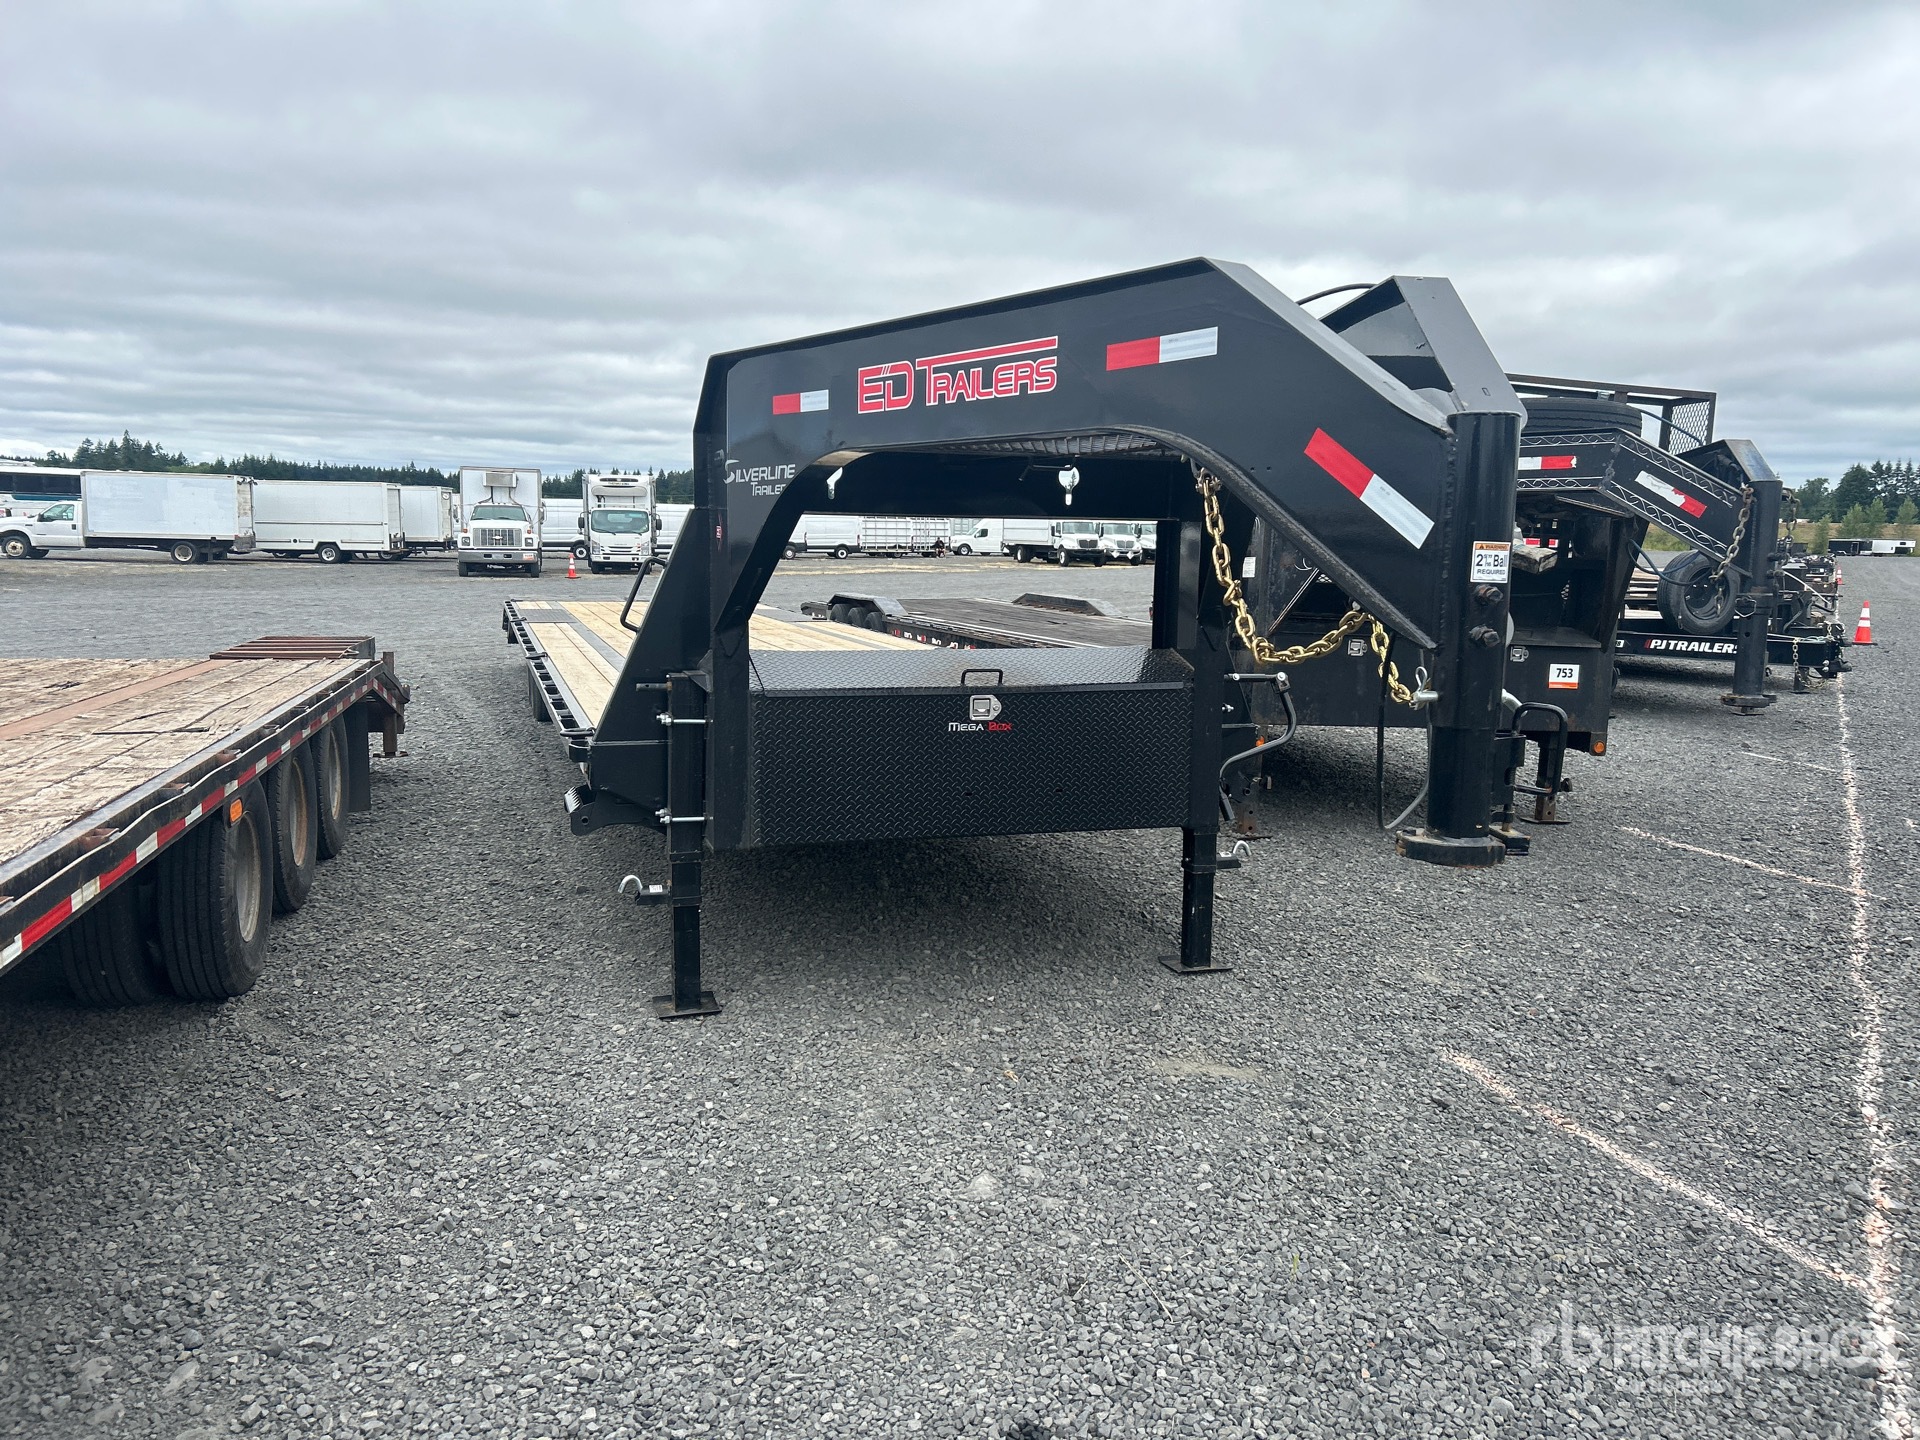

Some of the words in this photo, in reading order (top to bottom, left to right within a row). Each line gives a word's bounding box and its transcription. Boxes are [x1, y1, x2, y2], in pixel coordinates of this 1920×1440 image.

[857, 361, 914, 414] ED
[915, 336, 1058, 406] TRAILERS
[723, 460, 796, 484] SILVERLINE
[1649, 639, 1667, 650] PJ
[1556, 667, 1573, 678] 753
[948, 722, 984, 732] MEGA
[988, 721, 1013, 731] BOX
